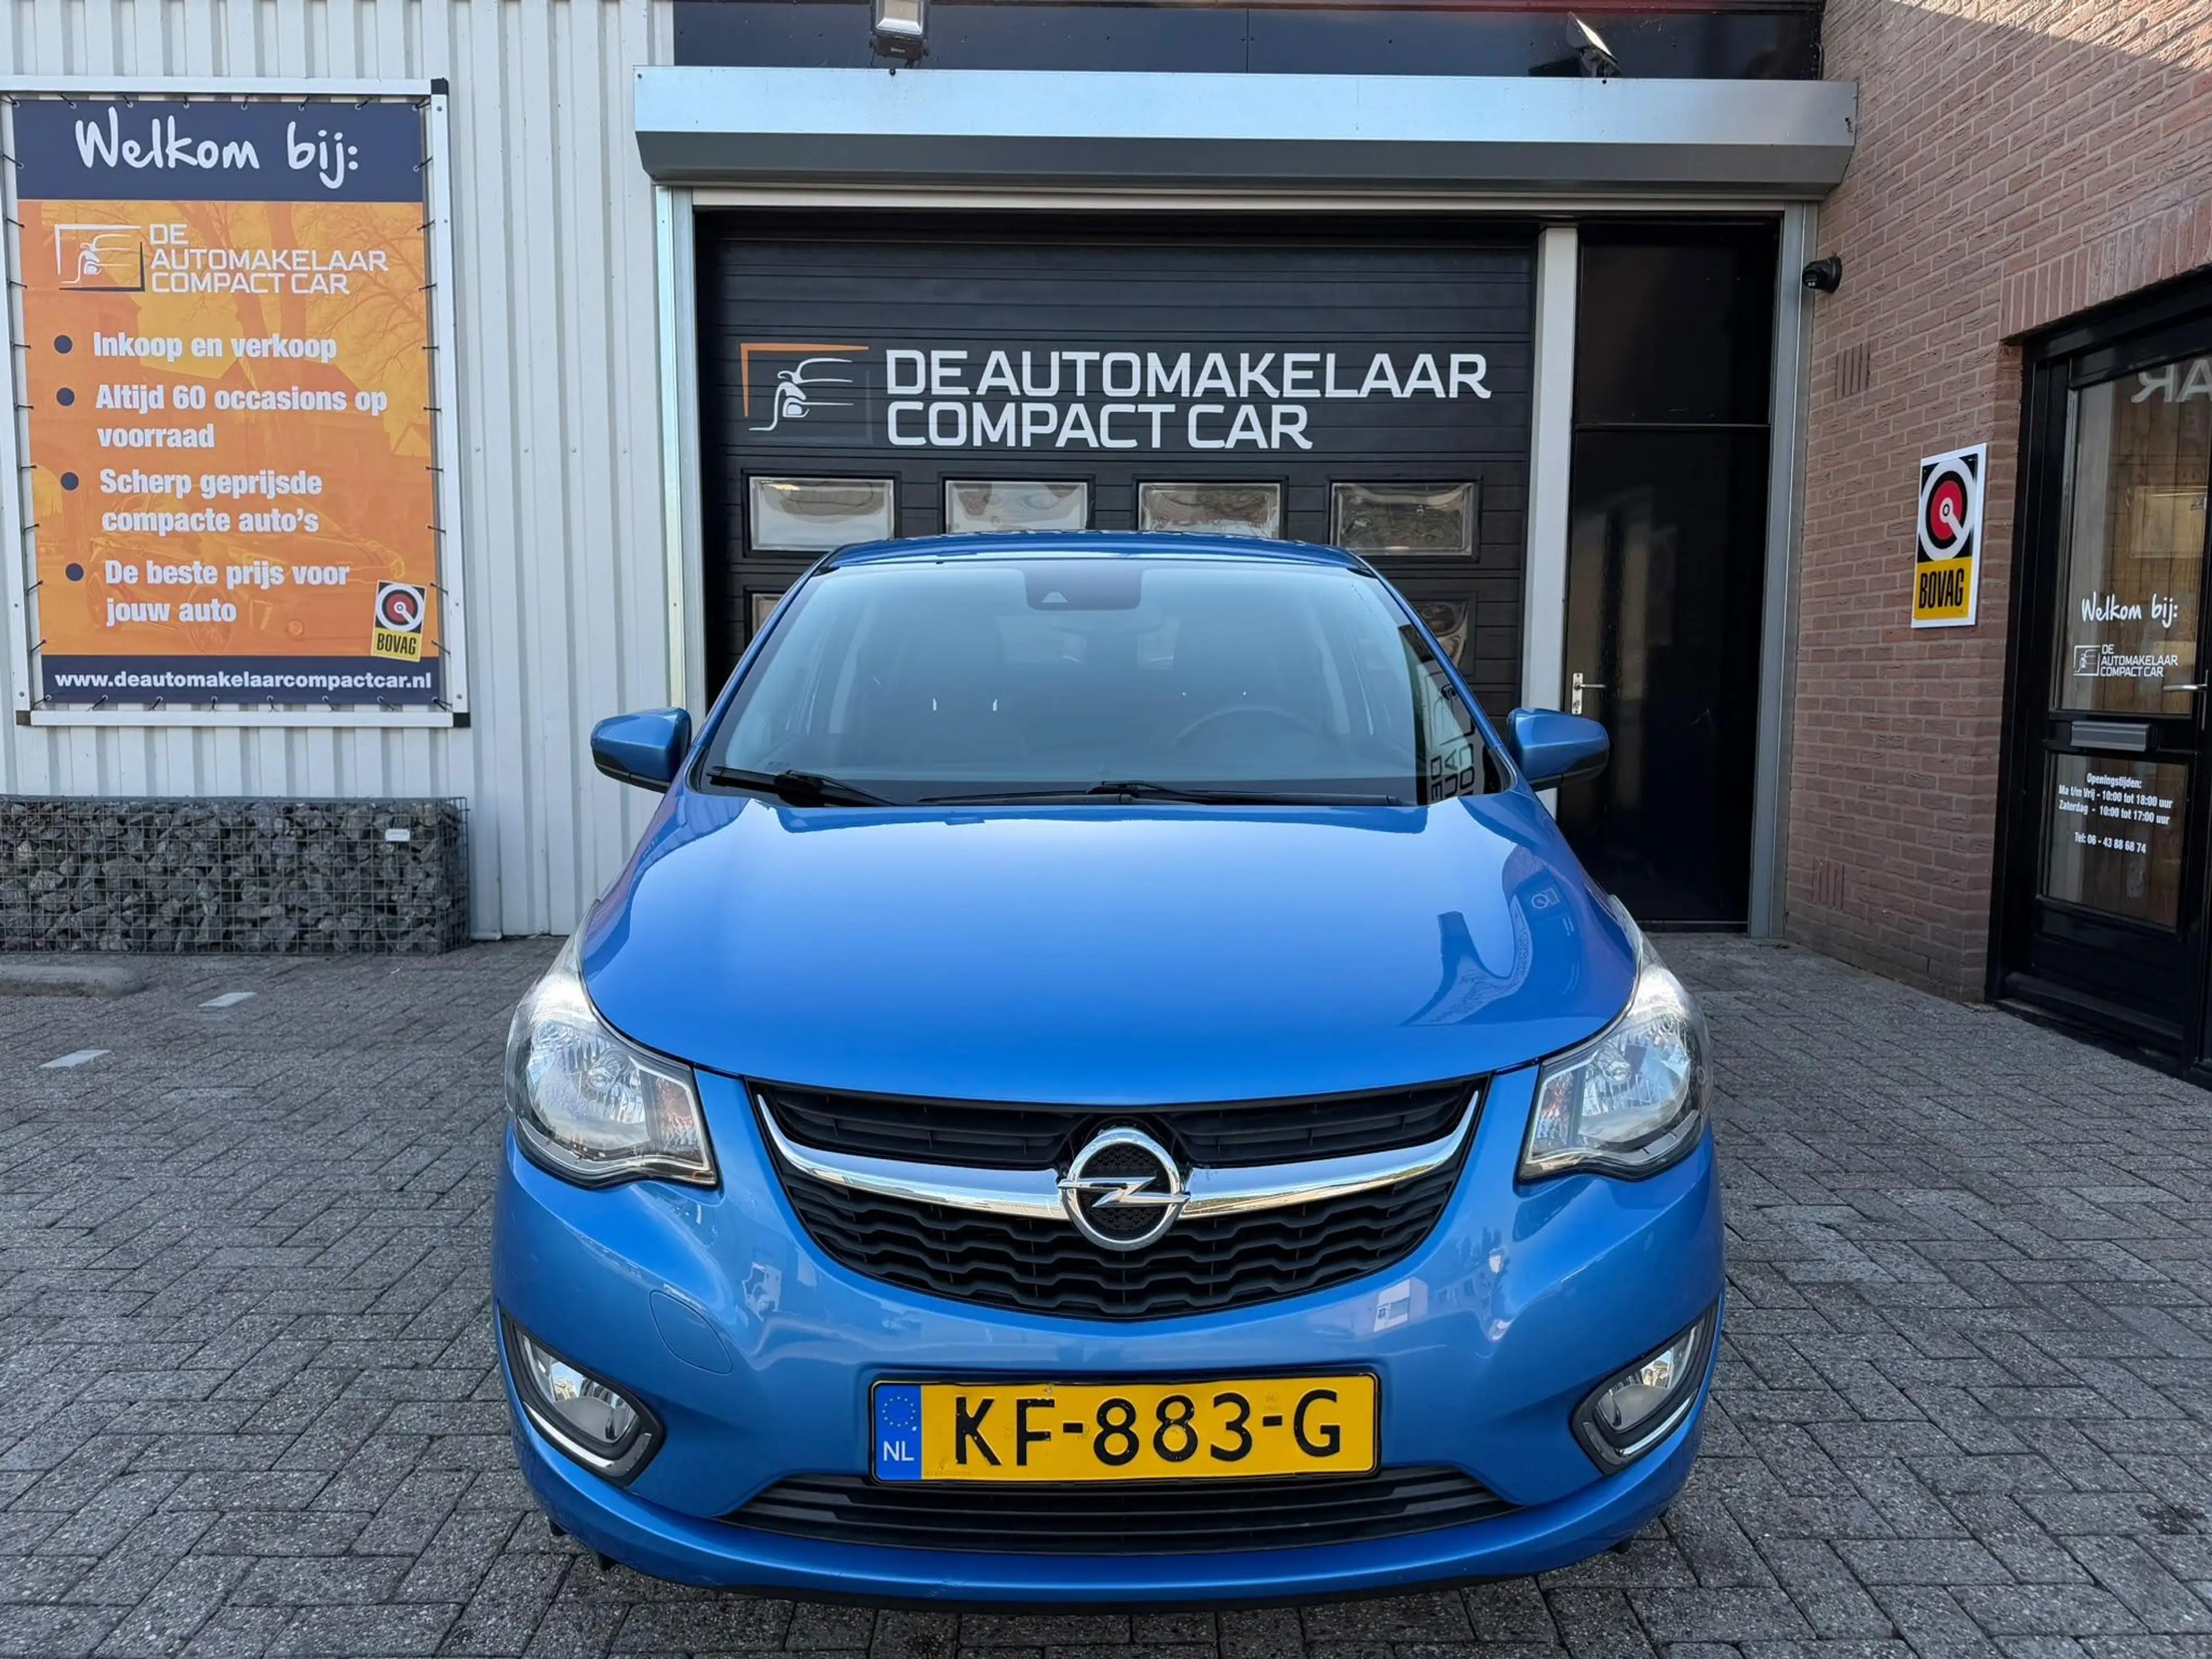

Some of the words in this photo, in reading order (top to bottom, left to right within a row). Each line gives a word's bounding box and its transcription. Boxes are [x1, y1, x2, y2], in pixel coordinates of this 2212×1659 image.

[74, 105, 260, 169] Welkom
[286, 121, 359, 189] bij:
[149, 223, 188, 245] DE
[150, 249, 389, 272] AUTOMAKELAAR
[151, 272, 286, 294] COMPACT
[290, 272, 350, 295] CAR
[93, 331, 182, 363] Inkoop
[191, 336, 223, 358] en
[230, 333, 337, 363] verkoop
[886, 349, 968, 396] DE
[975, 351, 1492, 400] AUTOMAKELAAR
[96, 384, 165, 415] Altijd
[173, 385, 206, 411] 60
[214, 386, 347, 411] occasions
[355, 391, 388, 416] op
[97, 423, 215, 449] voorraad
[886, 400, 1176, 448] COMPACT
[1187, 404, 1313, 450] CAR
[99, 468, 191, 498] Scherp
[200, 470, 322, 499] geprijsde
[101, 508, 230, 536] compacte
[238, 508, 319, 533] auto's
[105, 560, 138, 585] De
[146, 560, 218, 585] beste
[226, 560, 285, 590] prijs
[291, 563, 350, 586] voor
[1919, 568, 1964, 608] BOVAG
[105, 598, 171, 627] jouw
[178, 600, 237, 622] auto
[2081, 590, 2142, 622] Welkom
[2151, 593, 2178, 628] bij:
[377, 632, 416, 654] BOVAG
[2101, 644, 2115, 654] DE
[2100, 666, 2143, 677] COMPACT
[2144, 666, 2164, 677] CAR
[2101, 655, 2178, 666] AUTOMAKELAAR
[55, 672, 432, 691] www.deautomakelaarcompactcar.nl
[2086, 772, 2142, 789] Openingstijden:
[2058, 785, 2068, 796] Ma
[2084, 787, 2095, 801] Vrij
[2102, 790, 2122, 802] 10:00
[2123, 793, 2134, 804] tot
[2137, 794, 2157, 807] 18:00
[2159, 799, 2173, 809] uur
[2059, 800, 2088, 815] Zaterdag
[2100, 806, 2119, 819] 10:00
[2121, 808, 2131, 819] tot
[2134, 810, 2154, 823] 17:00
[2156, 815, 2170, 825] uur
[2075, 832, 2086, 843] Tel:
[2087, 835, 2096, 845] 06
[2103, 837, 2112, 848] 43
[2113, 839, 2123, 850] 88
[2125, 840, 2134, 851] 68
[2137, 843, 2146, 854] 74
[956, 1389, 1339, 1467] KF-883-G
[883, 1441, 914, 1462] NL
